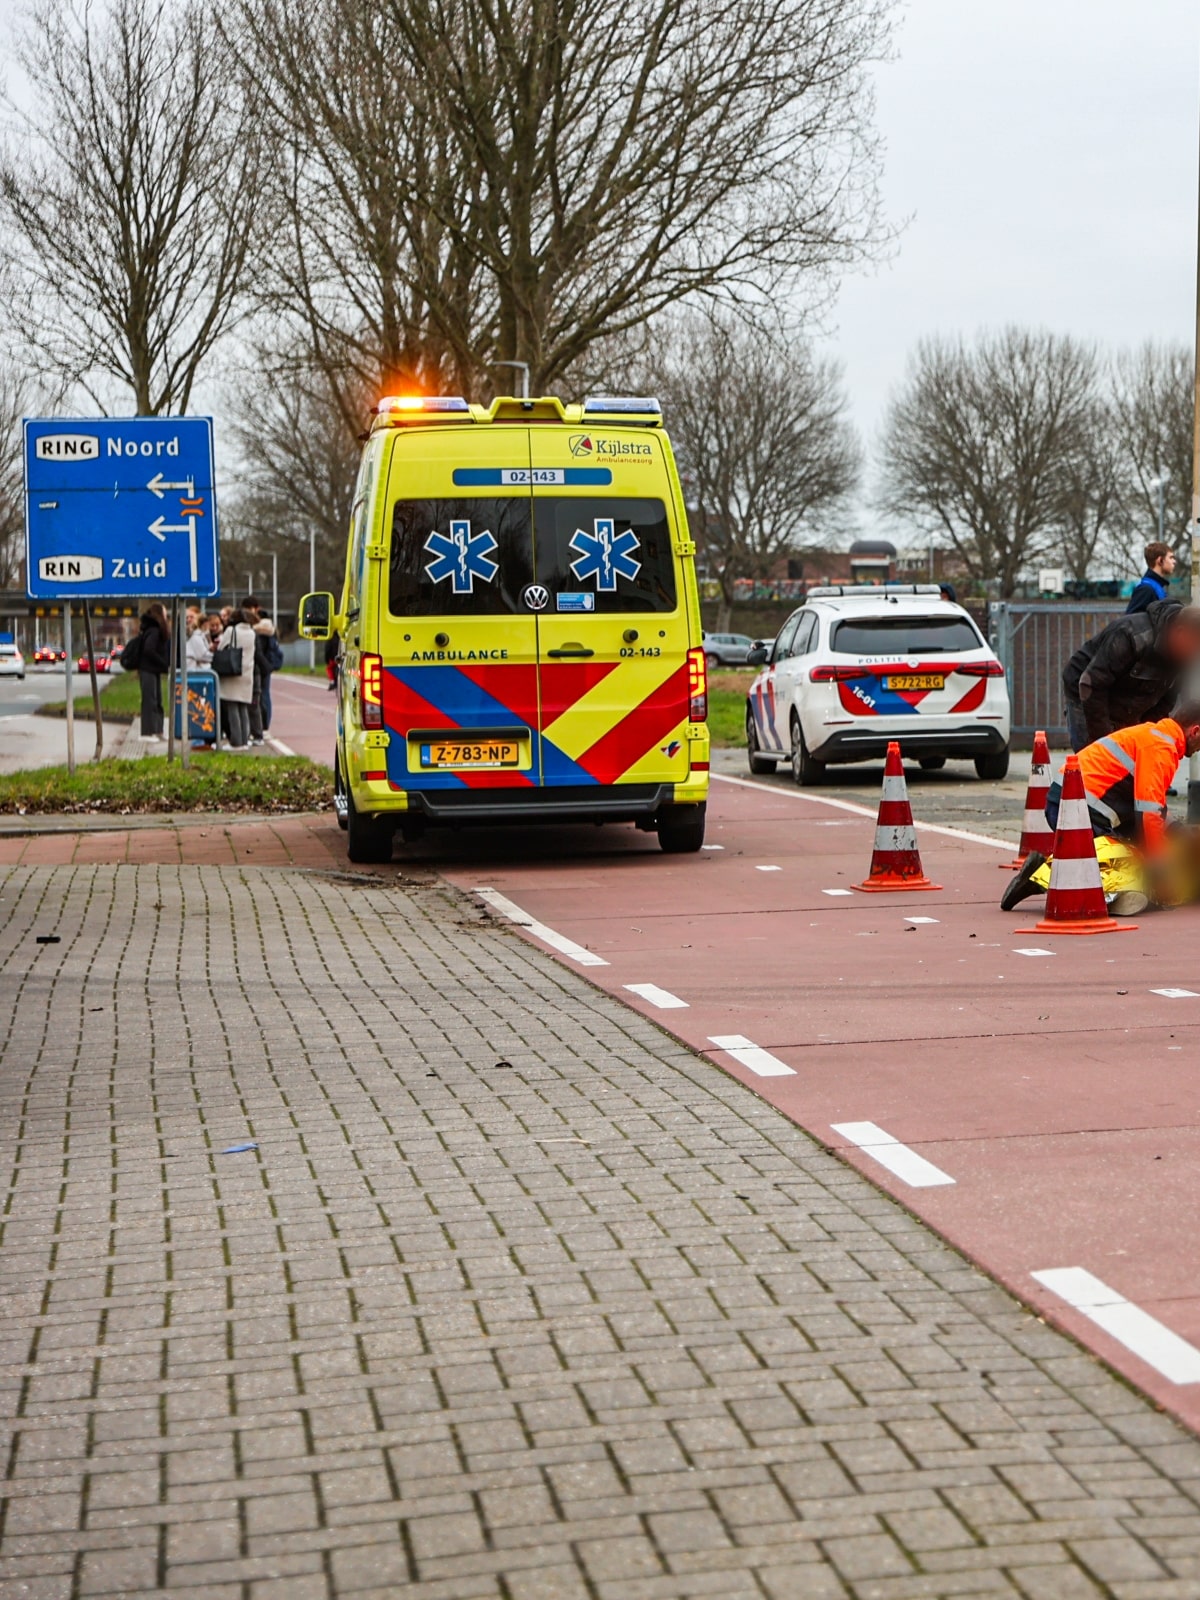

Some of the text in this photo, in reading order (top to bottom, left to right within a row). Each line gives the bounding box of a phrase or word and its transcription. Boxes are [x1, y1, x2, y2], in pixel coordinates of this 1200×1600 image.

[42, 436, 179, 457] RING Noord
[595, 440, 652, 457] Kijlstra
[596, 457, 653, 465] Ambulancezorg
[510, 470, 556, 483] 02-143
[111, 558, 167, 578] Zuid
[410, 649, 509, 661] AMBULANCE
[619, 647, 661, 658] 02-143
[858, 656, 904, 665] POLITIE
[891, 676, 940, 688] S-722-RG
[852, 686, 876, 708] 16-01
[436, 746, 511, 761] Z-783-NP
